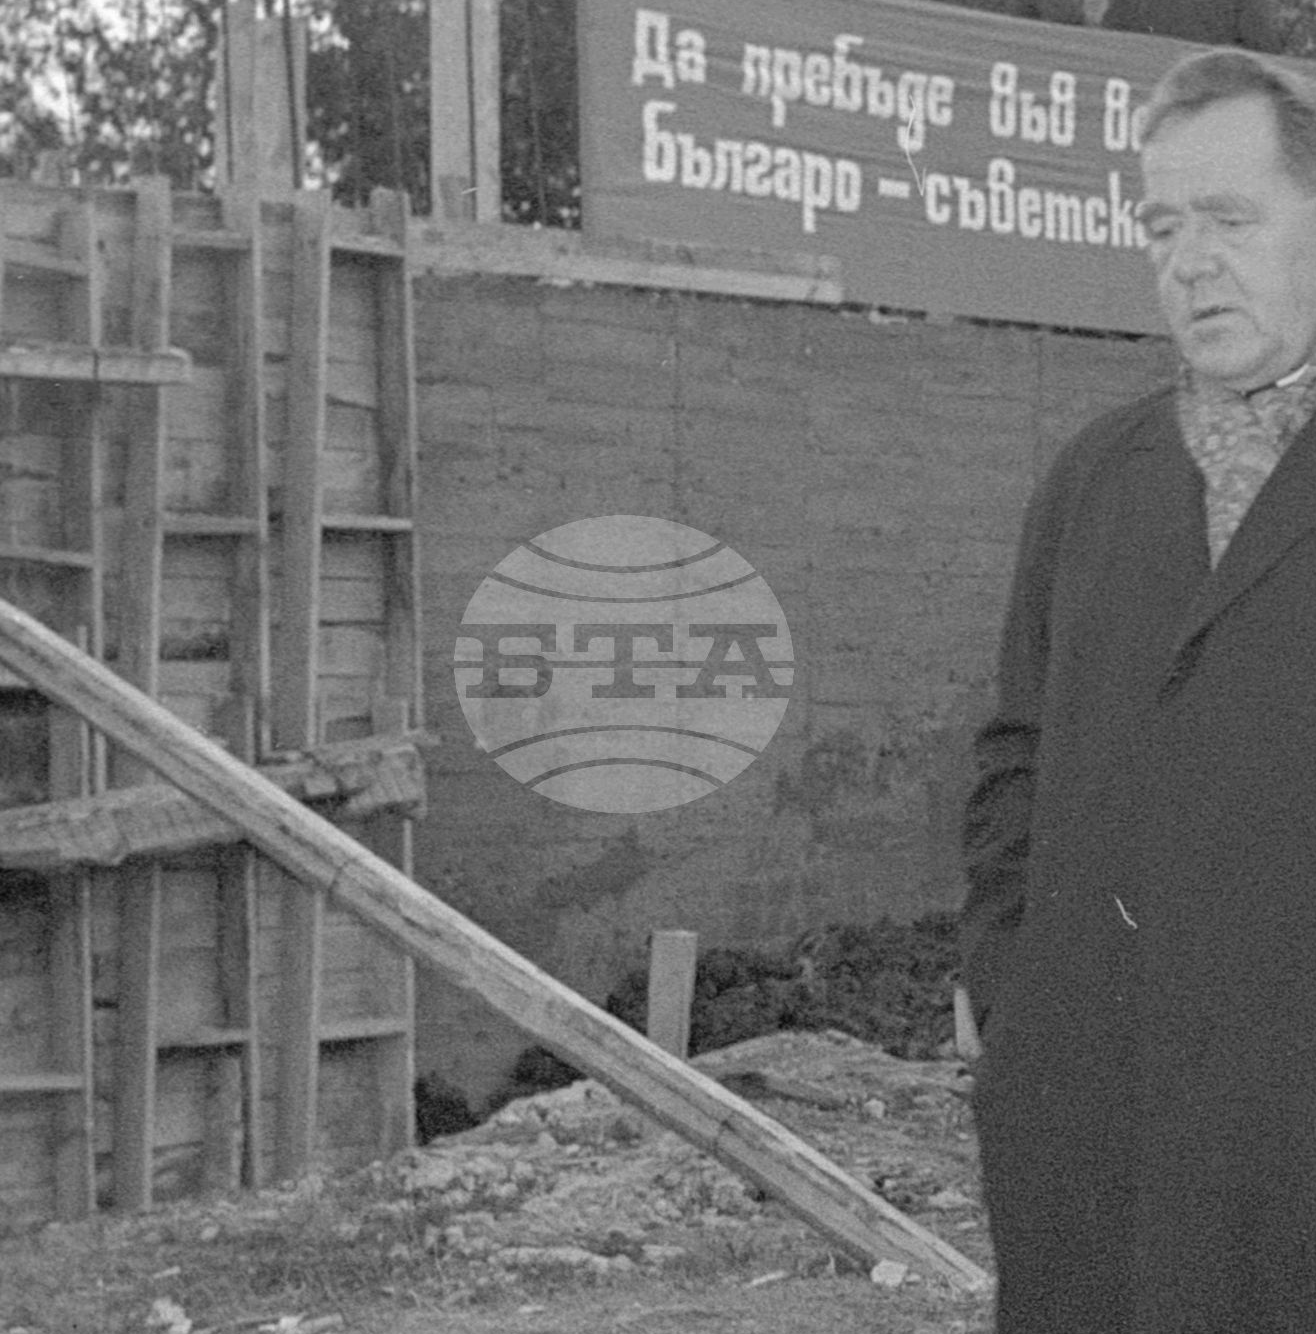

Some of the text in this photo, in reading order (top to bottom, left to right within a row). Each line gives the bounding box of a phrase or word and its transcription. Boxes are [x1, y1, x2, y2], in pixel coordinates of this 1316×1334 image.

[632, 9, 706, 89] Да
[741, 33, 955, 151] пребъде
[989, 62, 1076, 147] във
